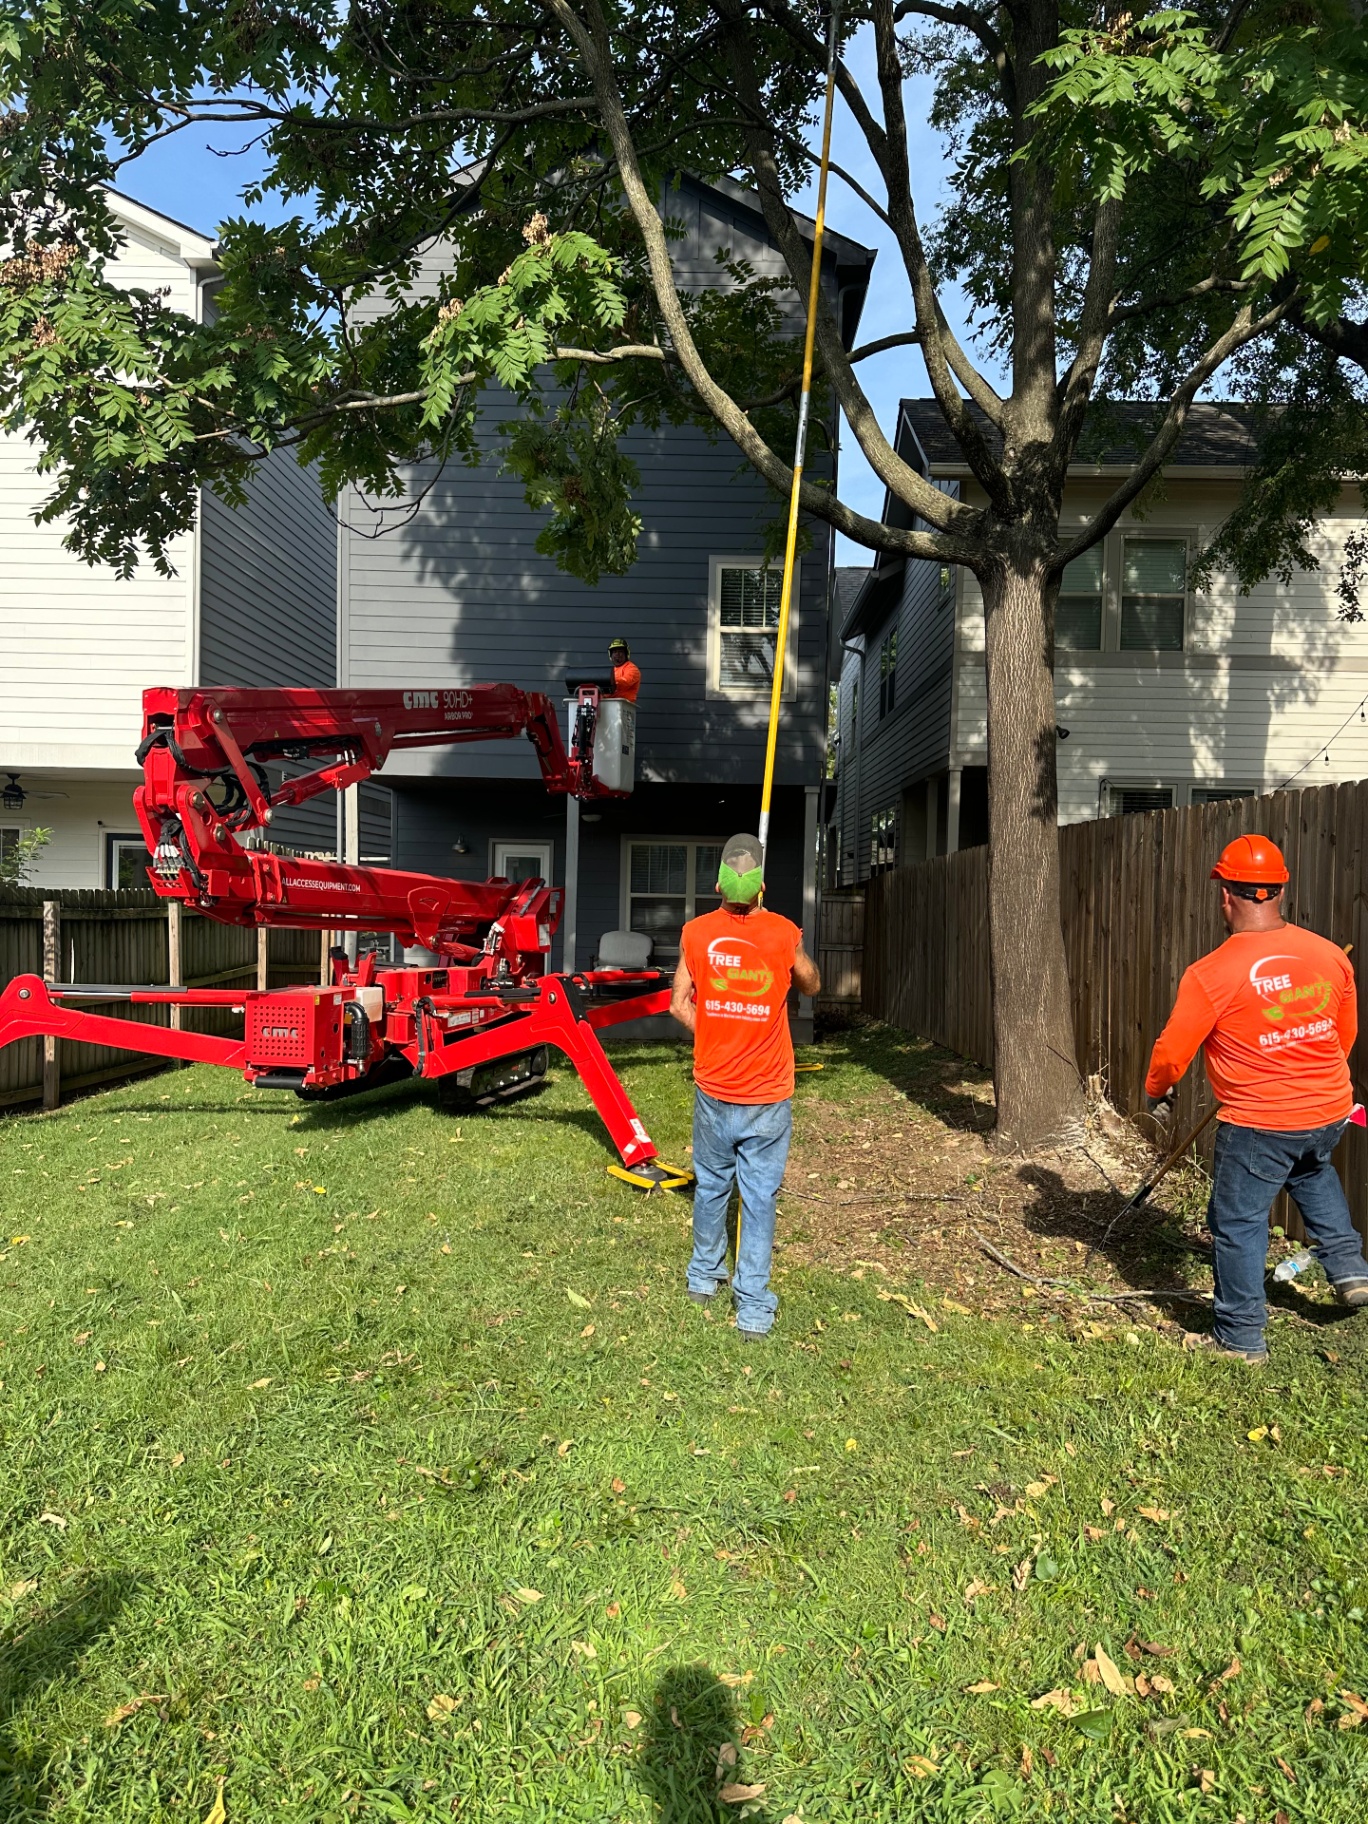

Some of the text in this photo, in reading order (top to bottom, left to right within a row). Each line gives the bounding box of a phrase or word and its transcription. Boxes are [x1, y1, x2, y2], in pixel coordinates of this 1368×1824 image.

[443, 690, 473, 709] 90HD+
[444, 711, 461, 720] ARBOR
[282, 877, 361, 892] ALLACCESSEQUIPMENT.COM
[707, 953, 742, 967] TREE
[727, 967, 774, 983] GIANTS
[1252, 974, 1292, 995] TREE
[1279, 981, 1332, 1003] GIANTS
[705, 999, 770, 1016] 615-430-5694
